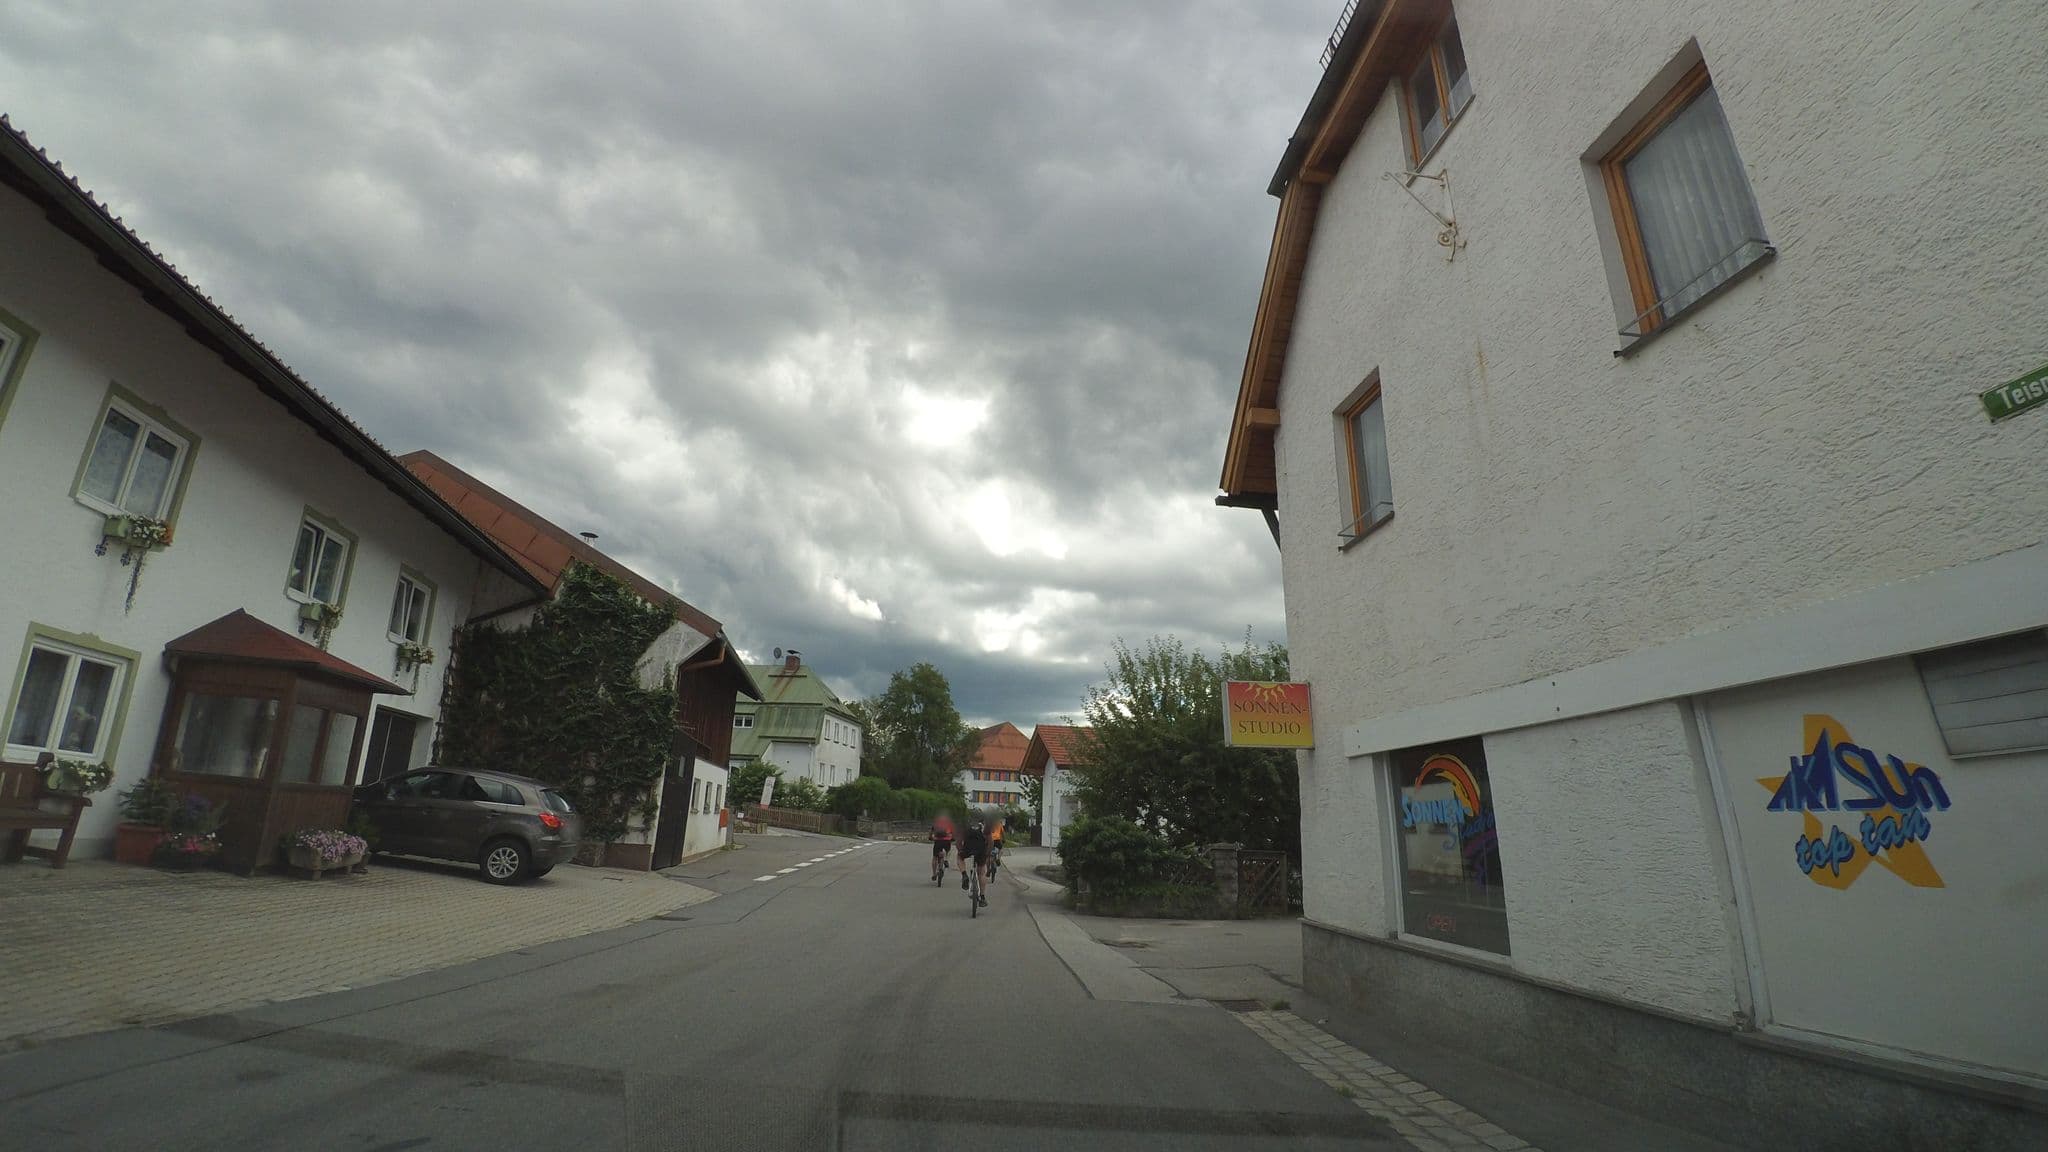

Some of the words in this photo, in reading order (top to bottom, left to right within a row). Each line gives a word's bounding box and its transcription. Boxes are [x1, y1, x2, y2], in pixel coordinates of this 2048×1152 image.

[1234, 700, 1309, 715] SONNEN-
[1238, 720, 1301, 735] STUDIO
[1795, 825, 1854, 878] top
[1859, 806, 1931, 856] tan
